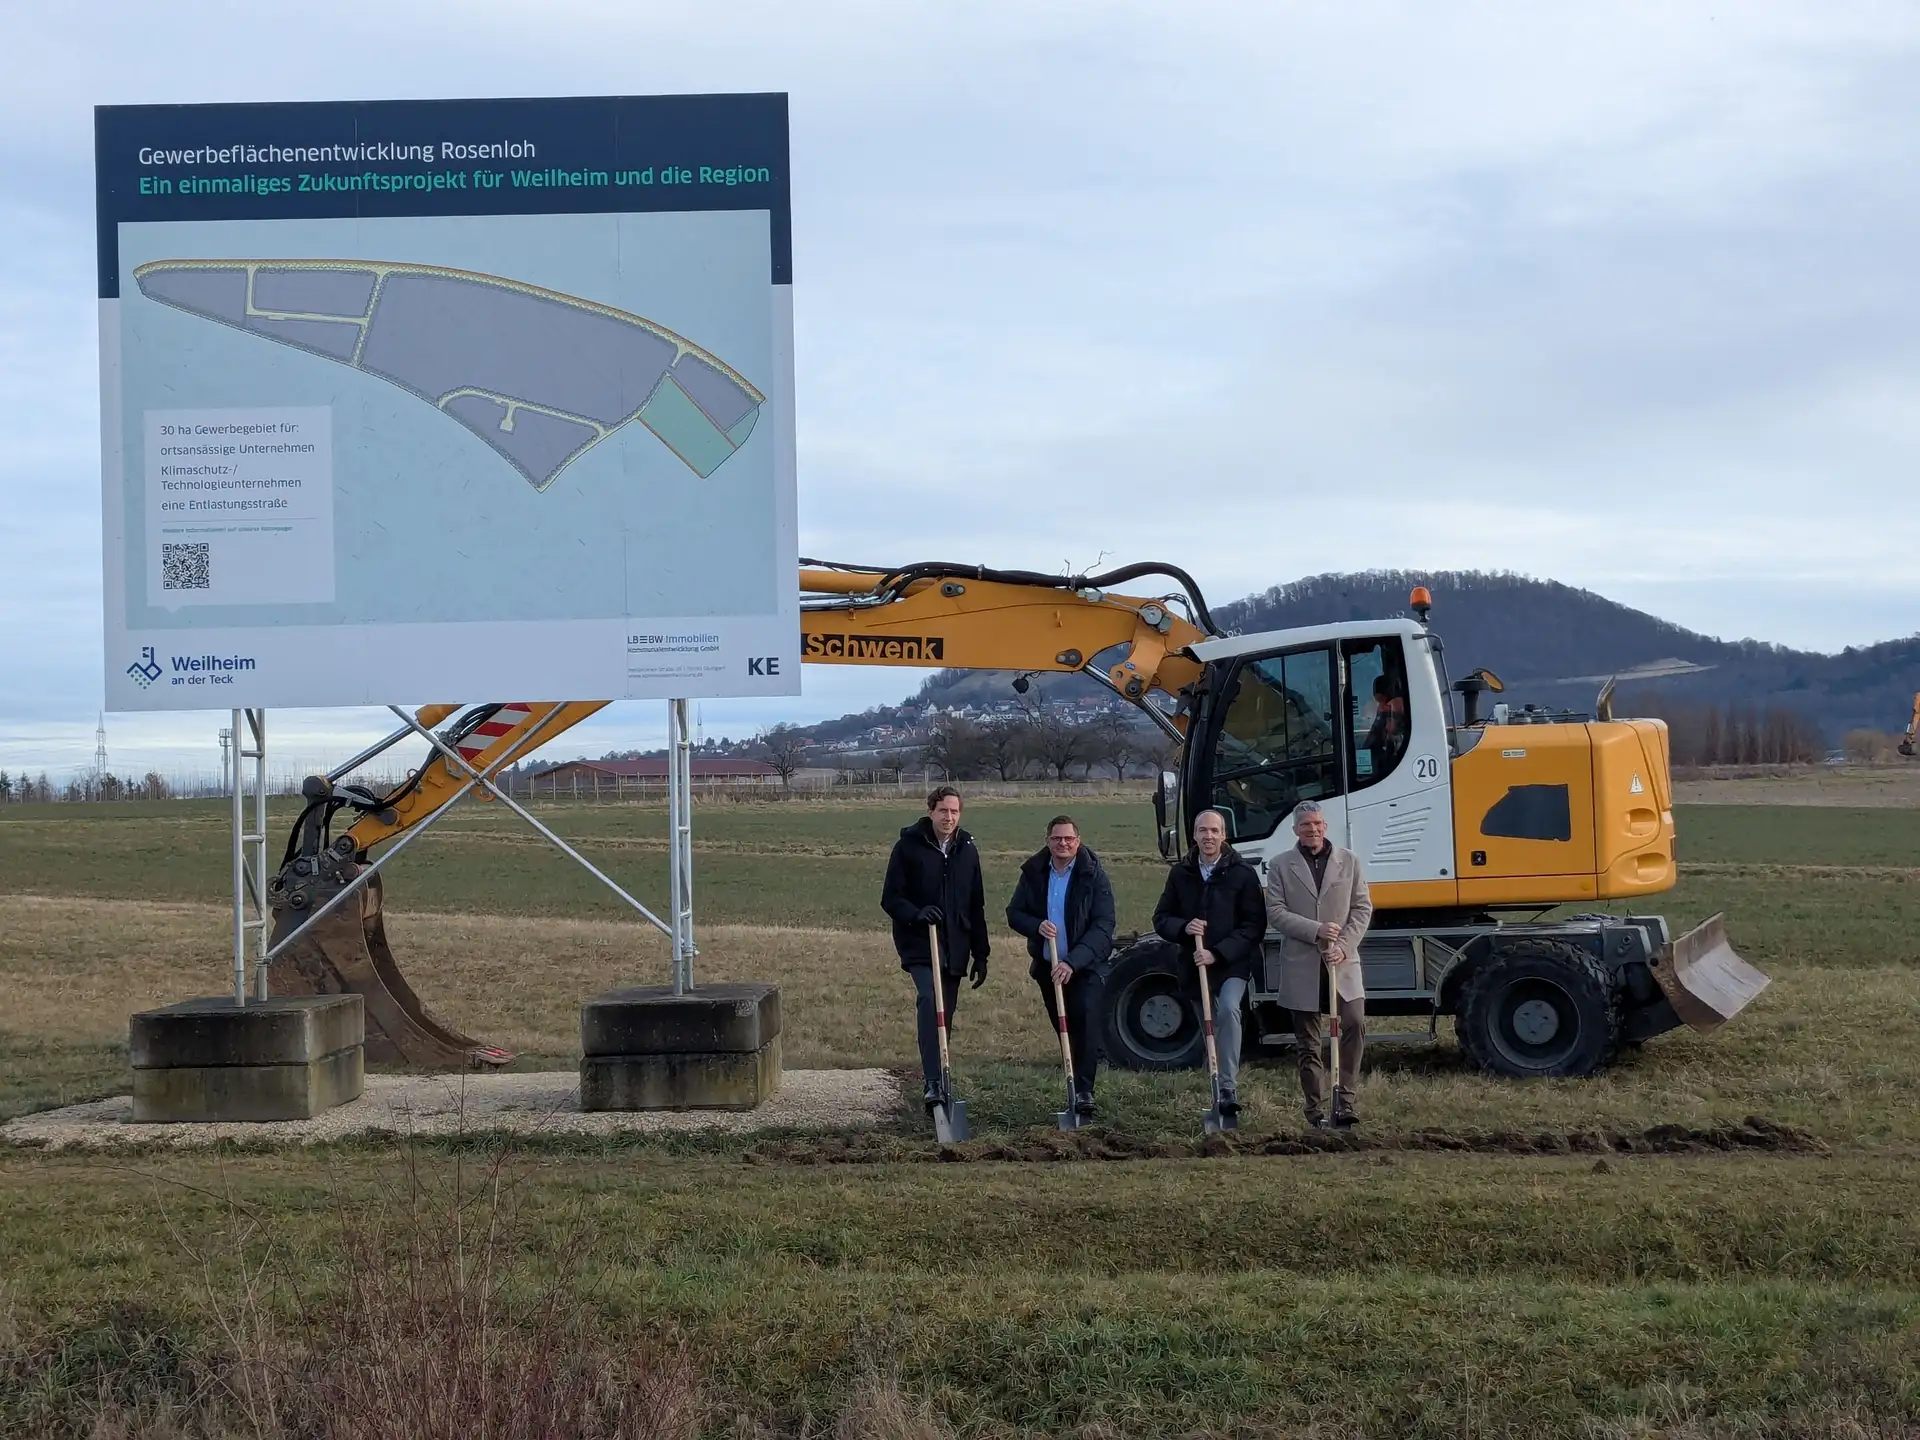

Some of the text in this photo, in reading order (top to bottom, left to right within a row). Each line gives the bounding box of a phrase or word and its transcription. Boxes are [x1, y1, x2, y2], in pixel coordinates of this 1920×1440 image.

[138, 140, 536, 165] Gewerbeflächenentwicklung Rosenloh
[139, 165, 770, 195] Ein einmaliges Zukunftsprojekt für Weilheim und die Region
[160, 425, 175, 435] 30
[178, 425, 192, 435] ha
[194, 423, 277, 436] Gewerbegebiet
[160, 443, 315, 456] ortsansässige Unternehmen
[161, 478, 302, 491] Technologieunternehmen
[161, 498, 288, 511] eine Entlastungsstraße
[665, 633, 719, 644] Immobilien
[804, 633, 938, 660] Schwenk
[171, 655, 256, 672] Weilheim
[748, 657, 780, 676] KE
[171, 674, 234, 685] an der Teck
[1417, 758, 1437, 778] 20
